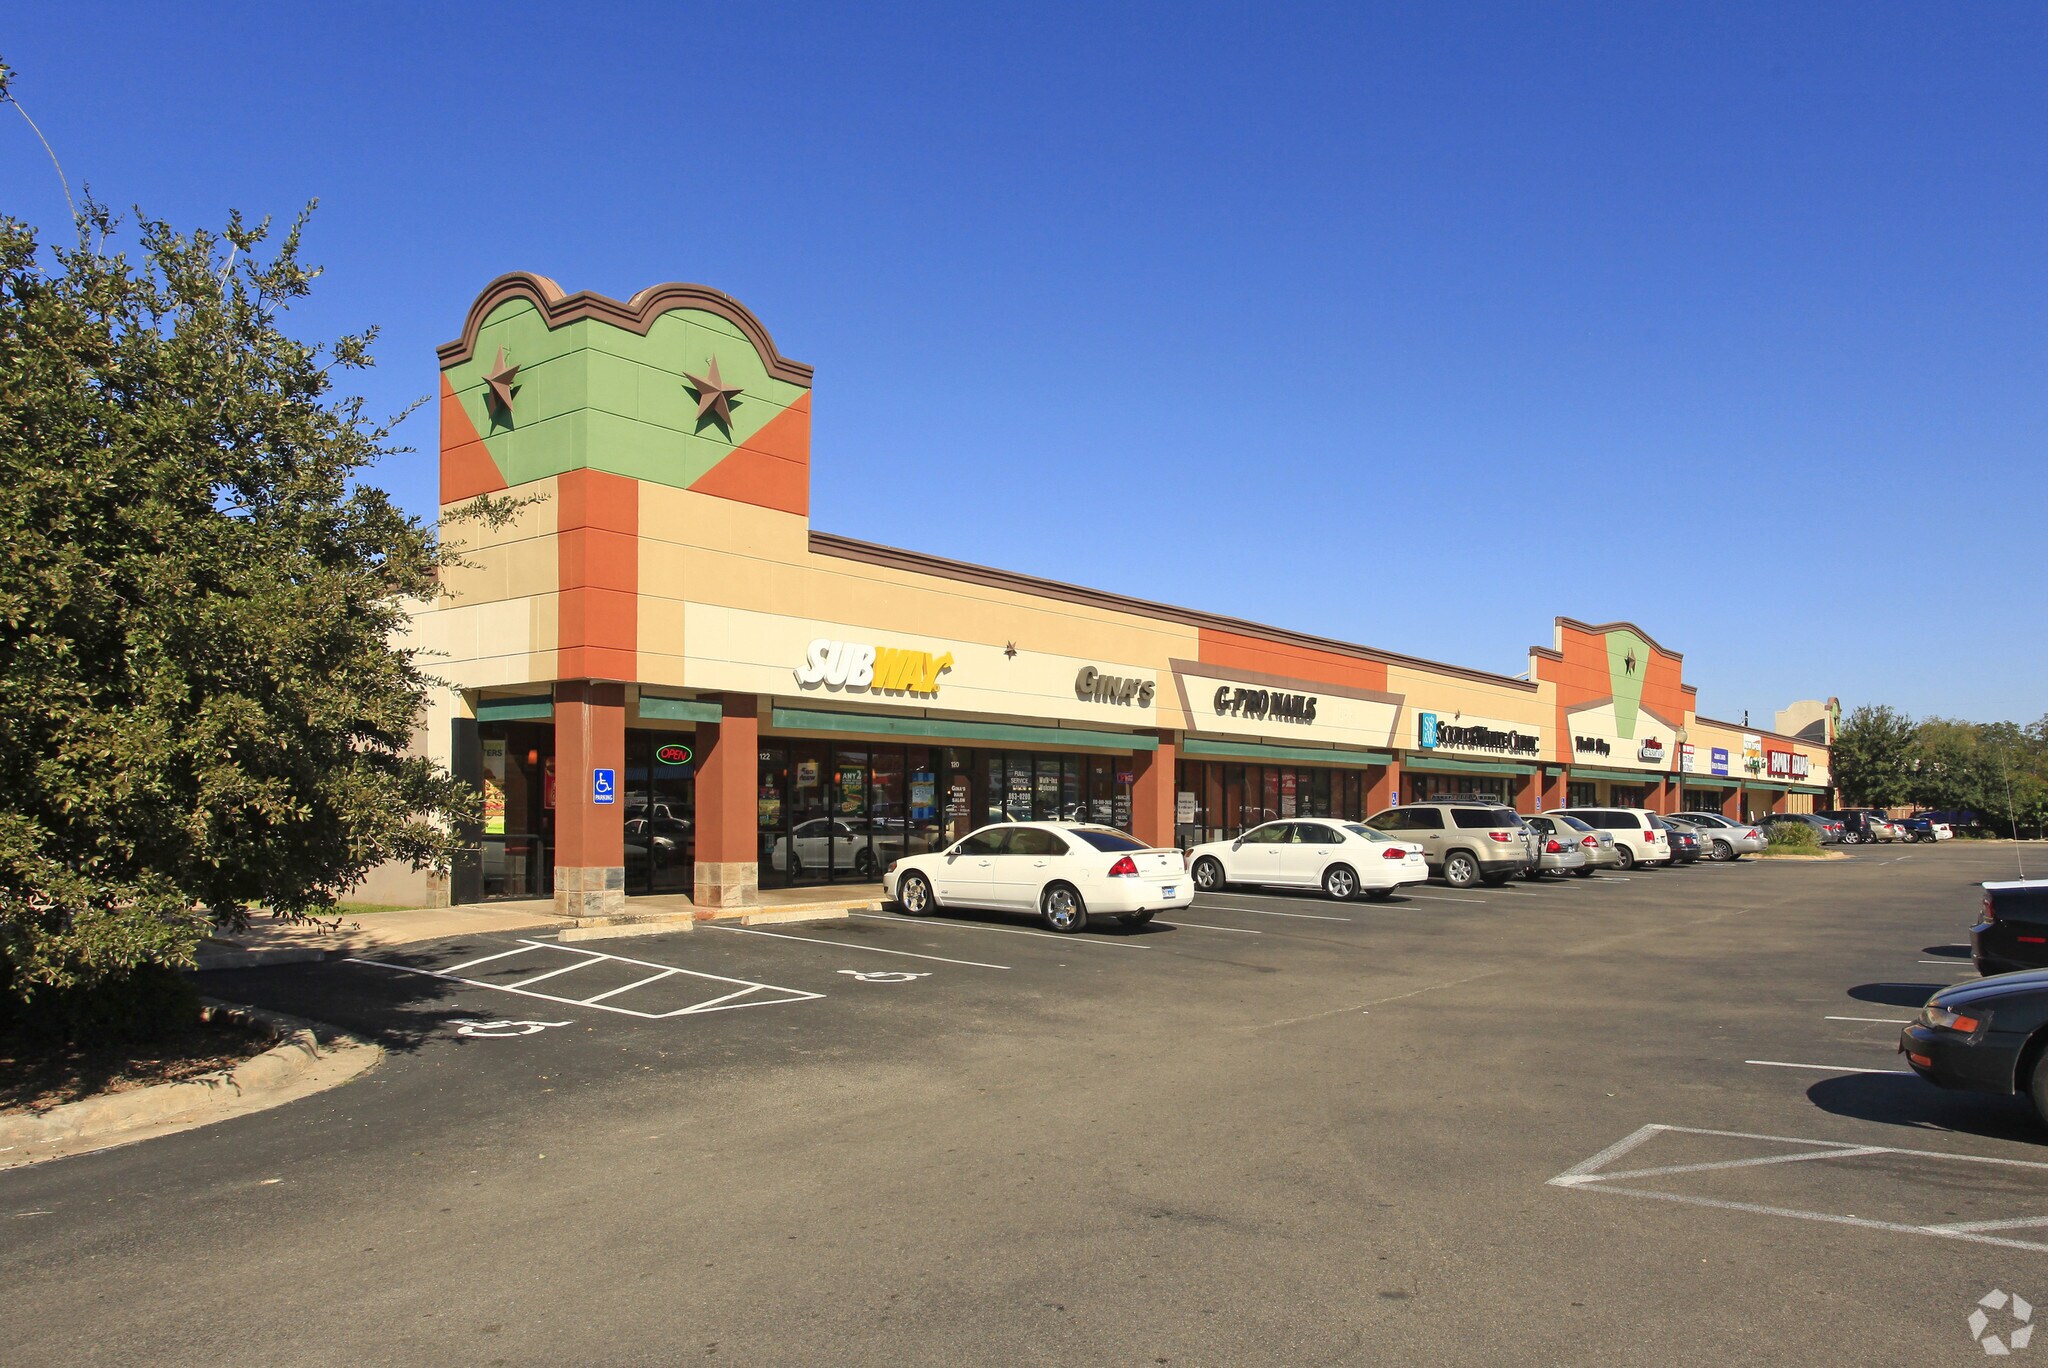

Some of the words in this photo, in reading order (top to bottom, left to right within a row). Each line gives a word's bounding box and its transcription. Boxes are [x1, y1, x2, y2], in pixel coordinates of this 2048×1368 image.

[794, 638, 954, 692] SUBWAY
[1214, 685, 1269, 713] G-PRO
[1270, 692, 1317, 721] NAILS
[661, 748, 687, 761] OPEN
[1771, 751, 1790, 773] FAMILY
[842, 772, 857, 780] ANY
[856, 770, 862, 780] 2
